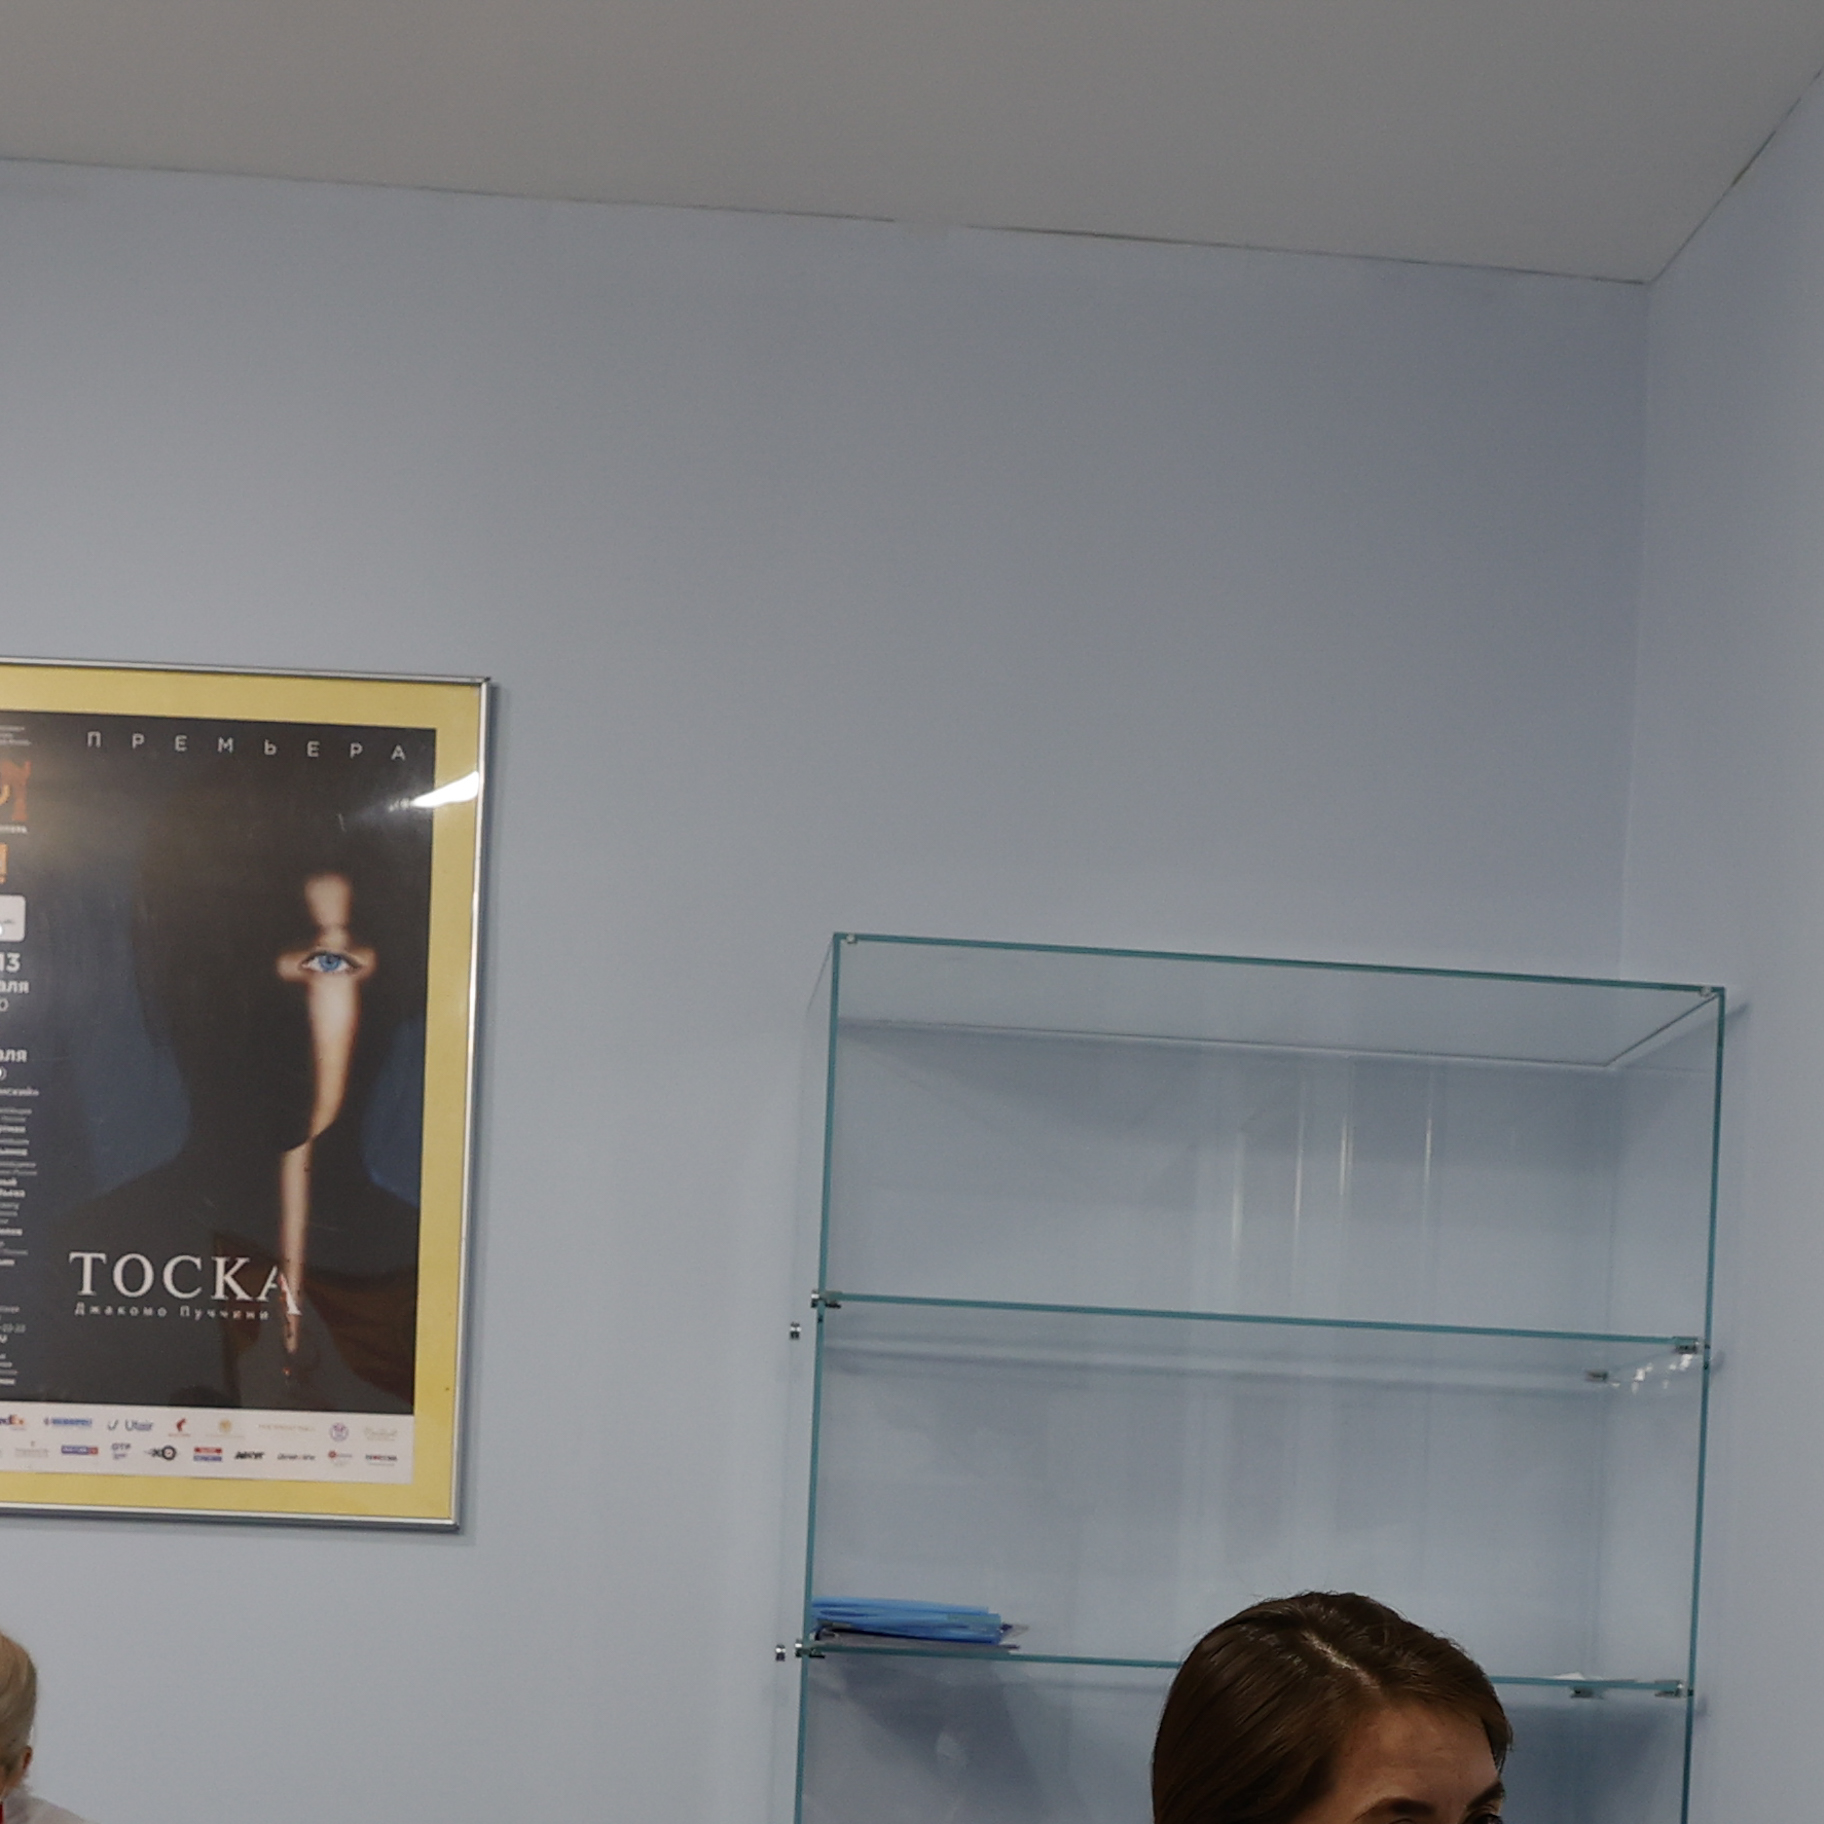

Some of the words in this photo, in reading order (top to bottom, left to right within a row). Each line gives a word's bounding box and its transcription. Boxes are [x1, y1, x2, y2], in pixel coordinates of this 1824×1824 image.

[87, 730, 407, 762] ПРЕМЬЕРА
[69, 1251, 302, 1317] ТОСКА
[75, 1302, 167, 1317] Джакомо
[180, 1305, 270, 1321] Пуччини
